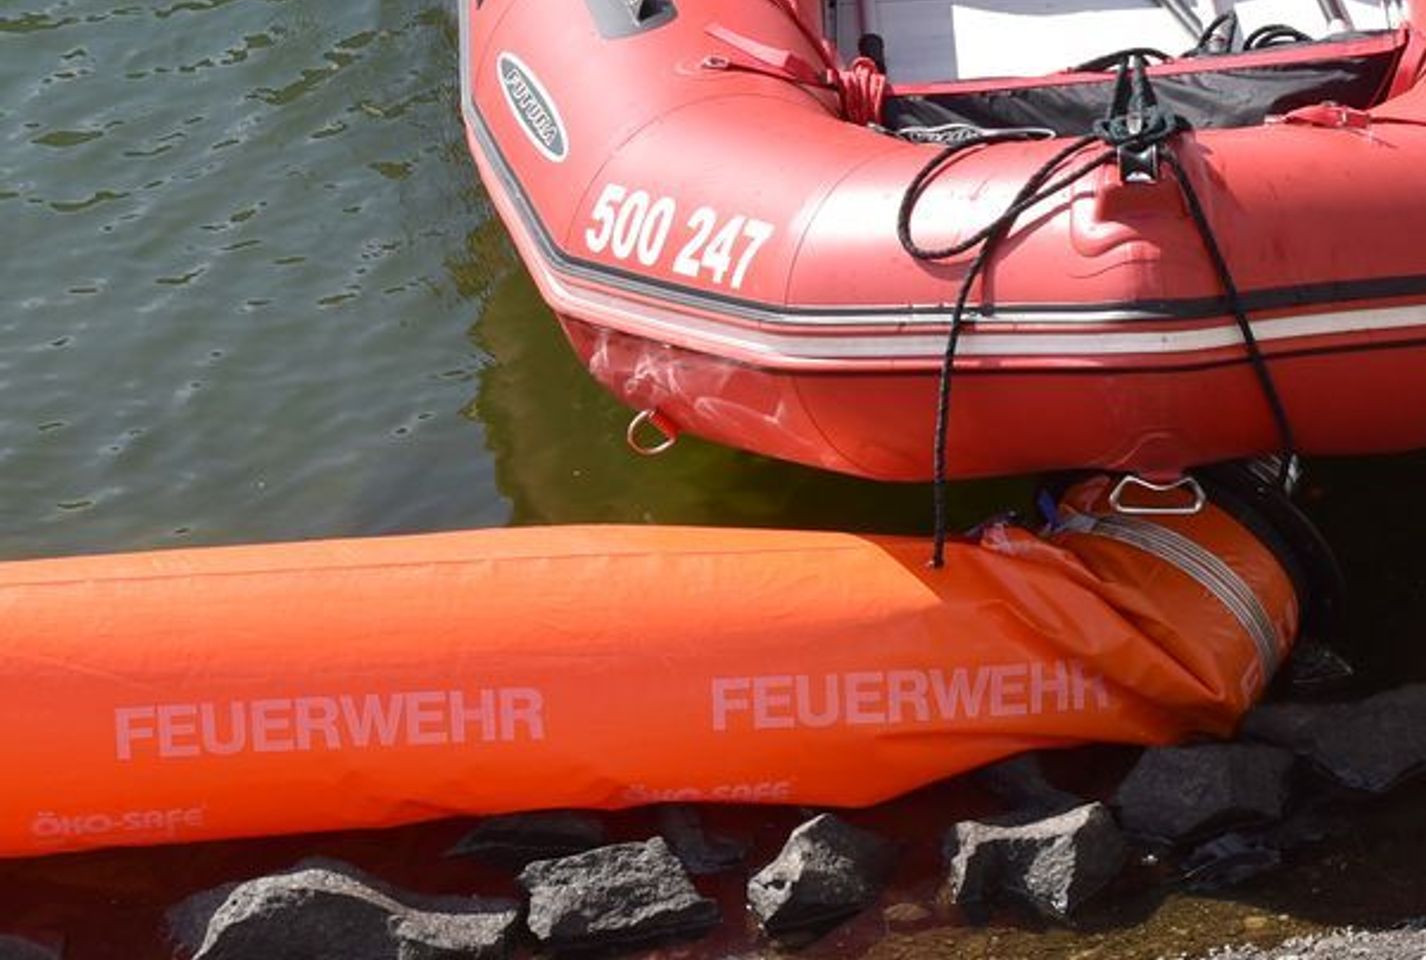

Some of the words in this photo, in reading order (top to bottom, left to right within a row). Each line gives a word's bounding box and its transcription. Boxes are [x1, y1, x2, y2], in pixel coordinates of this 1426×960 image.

[585, 183, 676, 267] 500
[672, 206, 775, 289] 247
[114, 687, 545, 761] FEUERWEHR
